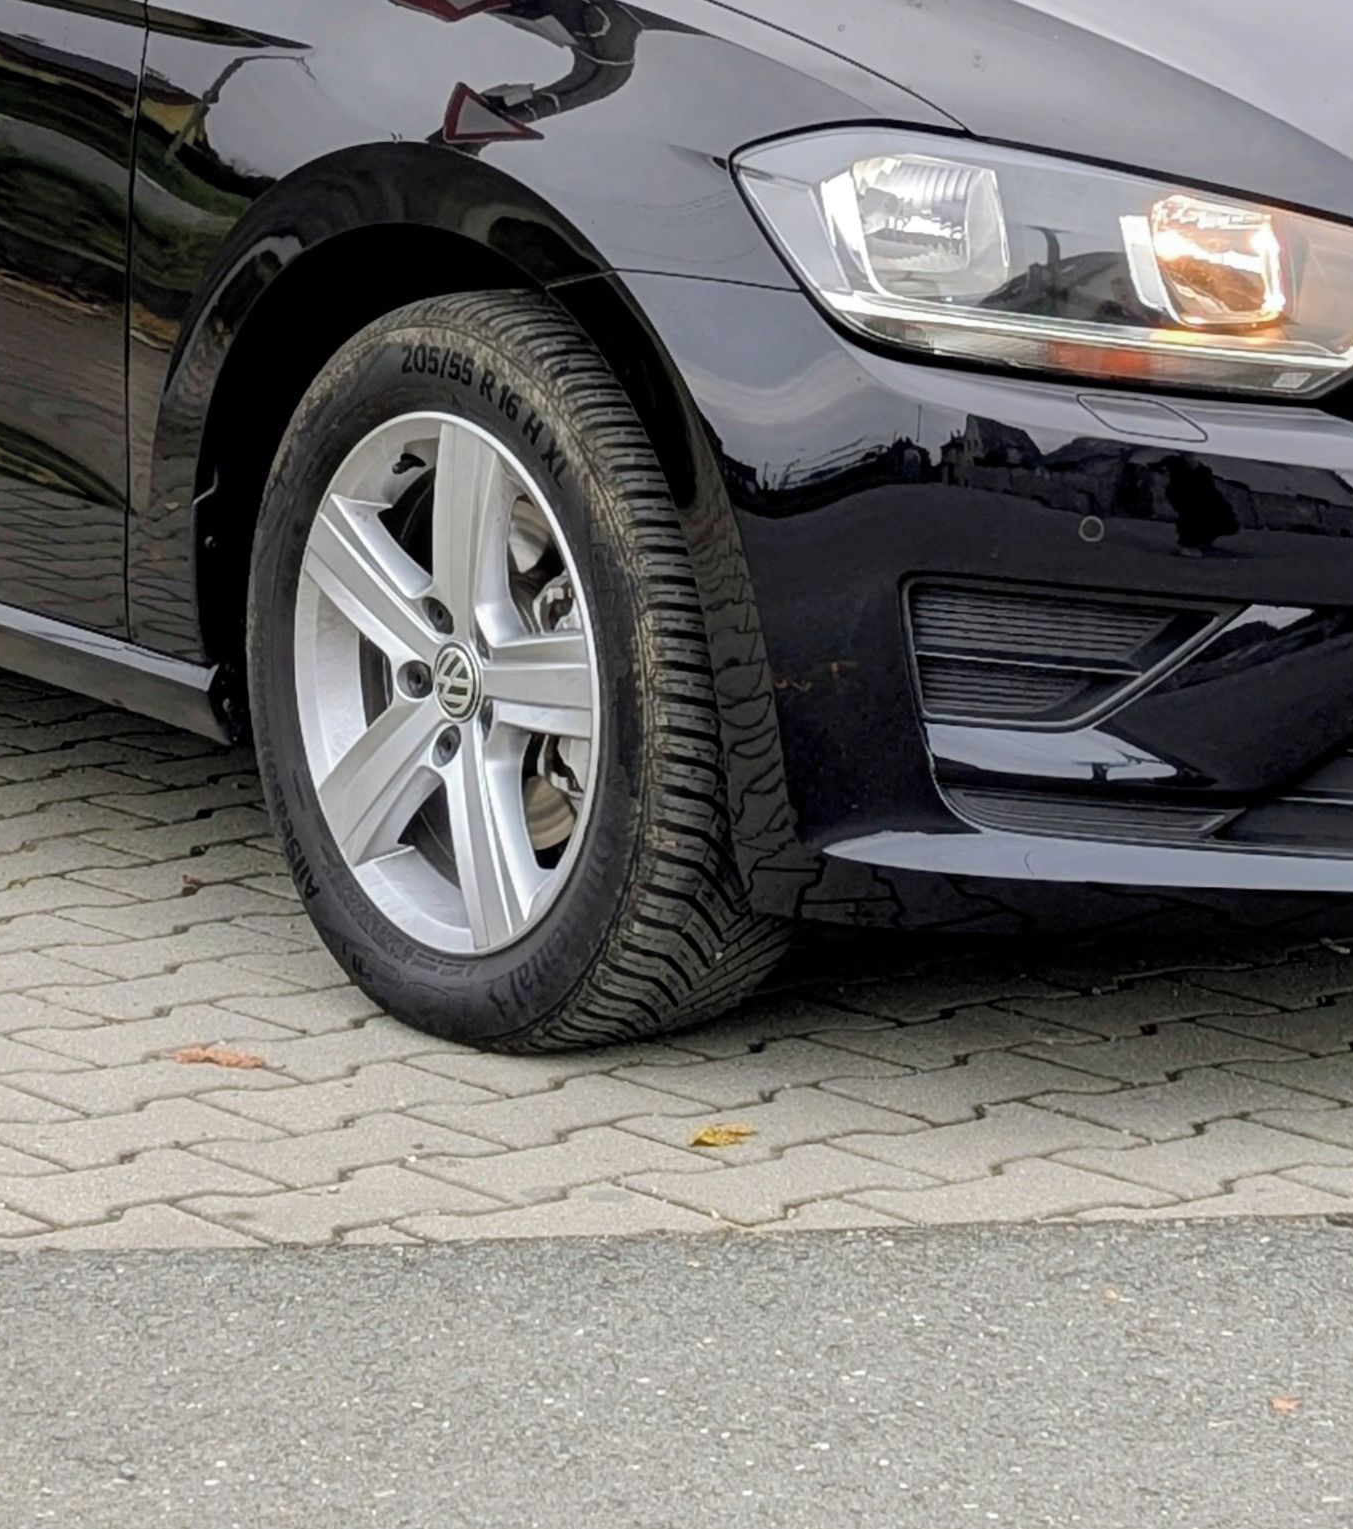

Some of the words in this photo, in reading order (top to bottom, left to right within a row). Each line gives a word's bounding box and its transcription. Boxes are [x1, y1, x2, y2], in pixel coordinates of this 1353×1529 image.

[401, 343, 475, 387] 205/55
[479, 370, 496, 403] R
[498, 383, 522, 422] 16
[522, 410, 544, 446] H
